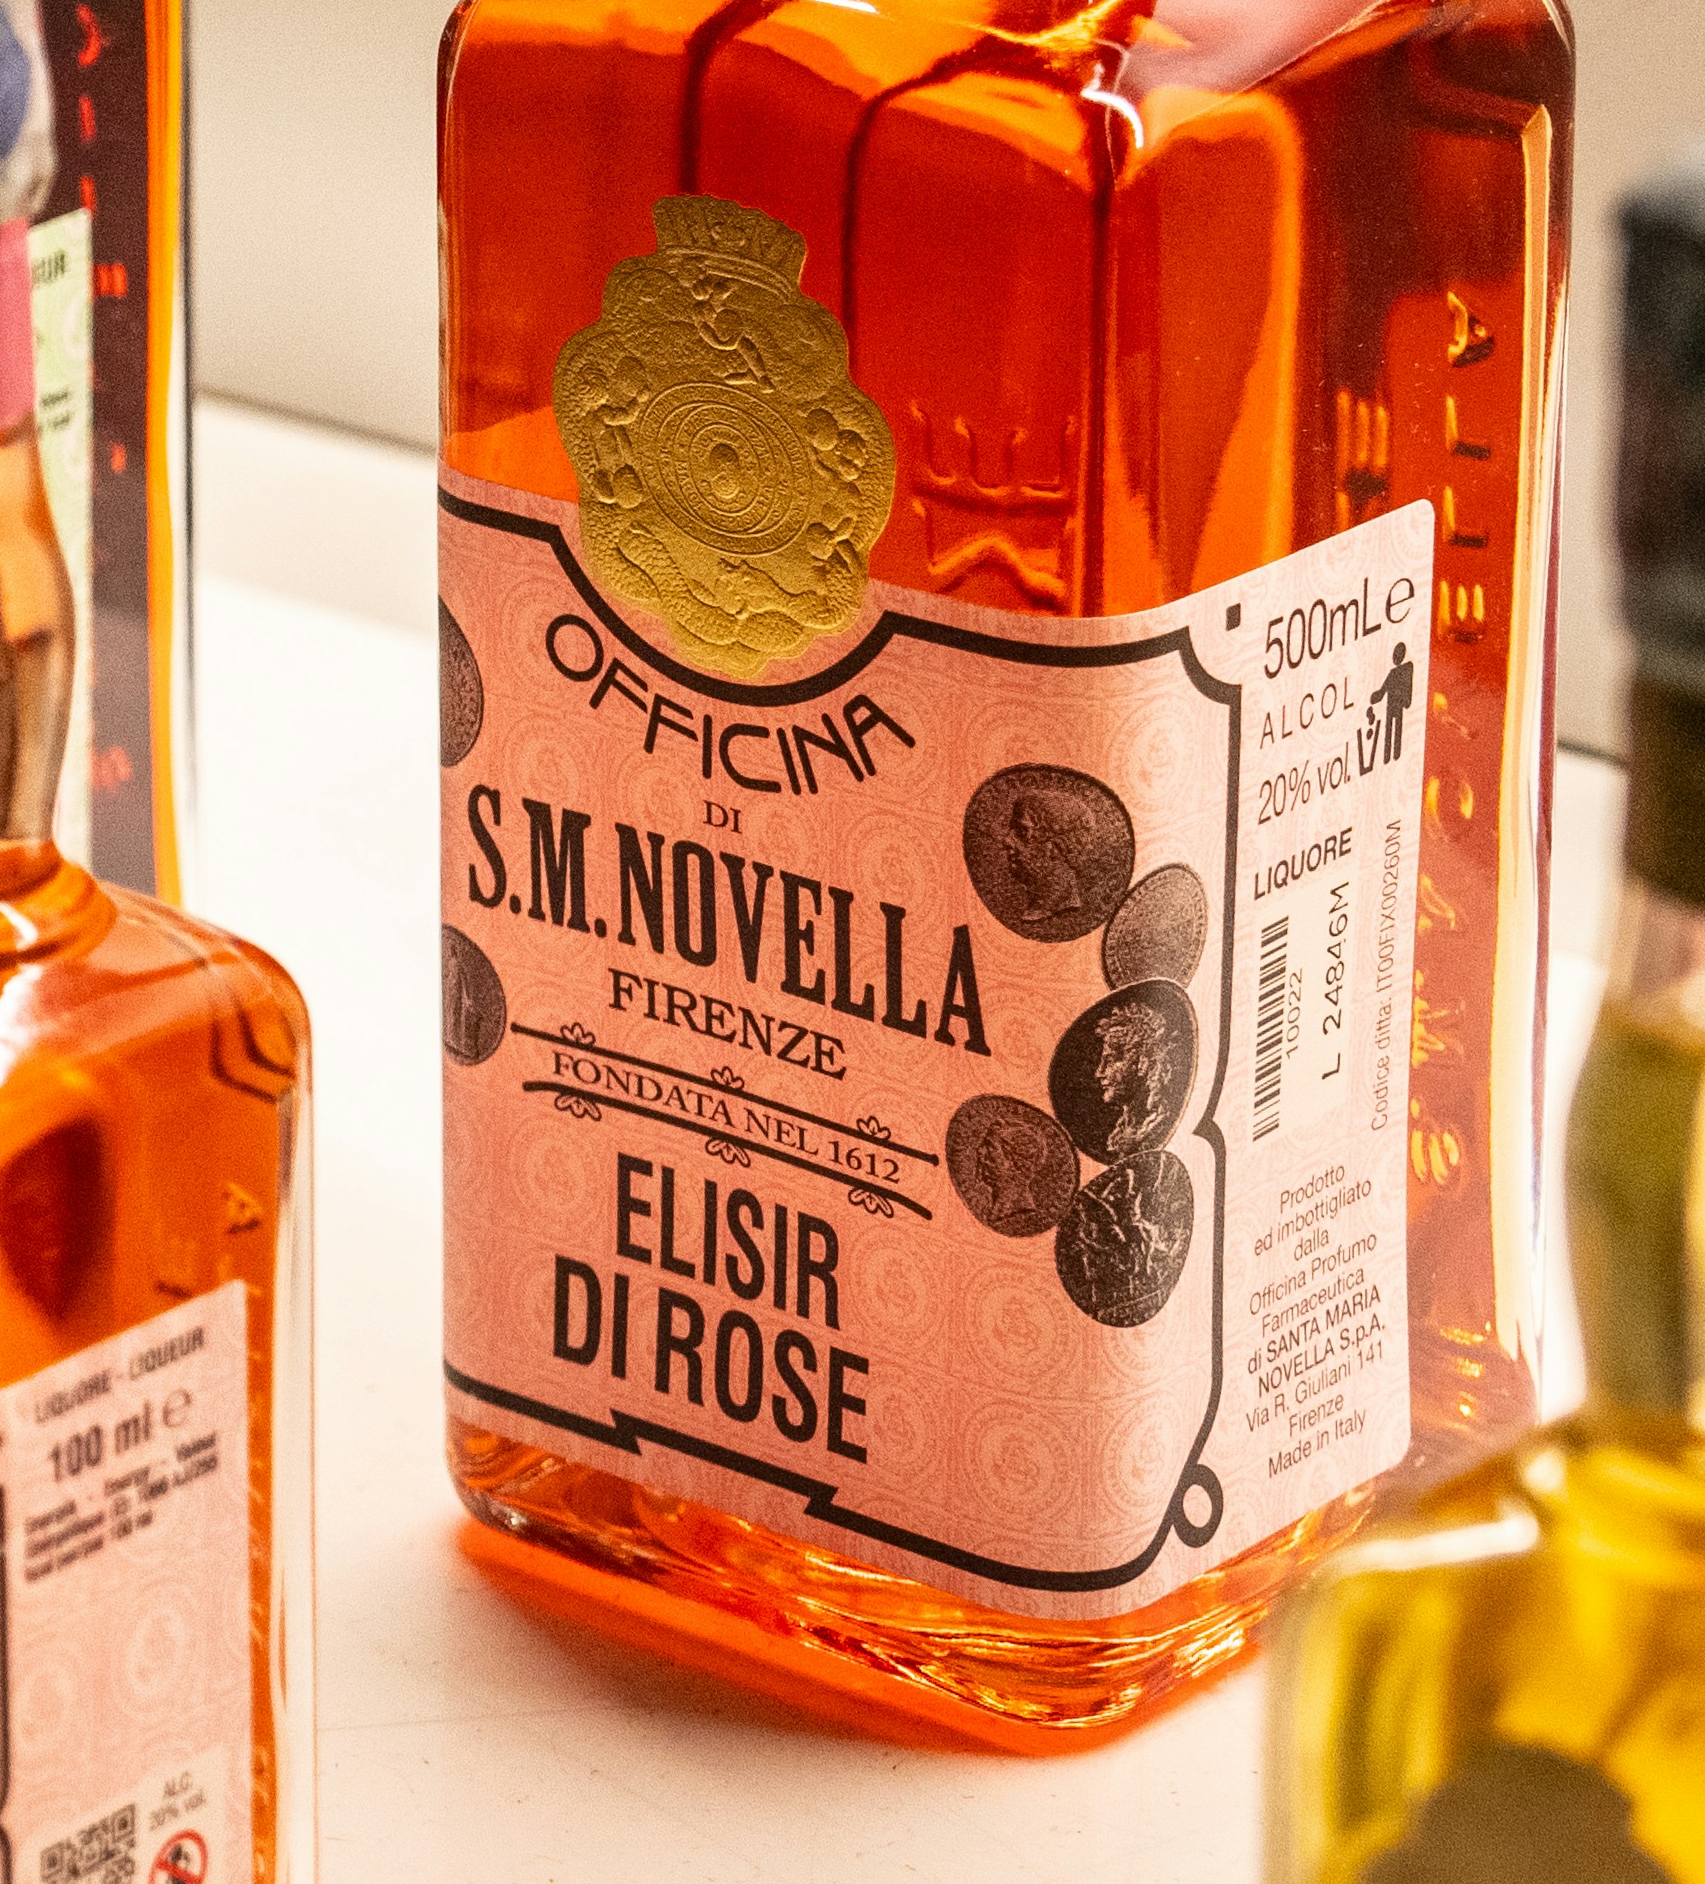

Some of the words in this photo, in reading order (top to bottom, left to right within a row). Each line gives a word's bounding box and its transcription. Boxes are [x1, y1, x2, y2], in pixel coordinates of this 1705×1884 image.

[545, 614, 916, 796] OFFICINA
[1260, 676, 1354, 750] ALCOL
[702, 800, 742, 834] DI
[1257, 759, 1311, 826] 20%
[1317, 741, 1351, 797] vol.
[1254, 826, 1353, 901] LIQUORE
[468, 783, 992, 1057] S.M.NOVELLA
[1322, 881, 1350, 1036] 24846M
[608, 967, 847, 1080] FIRENZE
[1286, 967, 1304, 1060] 10022
[1374, 997, 1392, 1049] ditta:
[1321, 1052, 1341, 1081] L
[1371, 1055, 1391, 1132] Codice
[551, 1051, 735, 1128] FONDATA
[744, 1108, 819, 1155] NEL
[828, 1138, 901, 1184] 1612
[1253, 1230, 1274, 1257] ed
[1276, 1179, 1373, 1245] imbottigliato
[1279, 1164, 1346, 1214] Prodotto
[616, 1152, 841, 1330] ELISIR
[1249, 1275, 1307, 1316] Officina
[1311, 1233, 1378, 1282] Profumo
[1293, 1228, 1330, 1262] dalla
[1247, 1348, 1263, 1375] di
[1266, 1321, 1321, 1365] SANTA
[1325, 1284, 1382, 1330] MARIA
[1261, 1267, 1366, 1339] Farmaceutica
[552, 1255, 631, 1379] DI
[654, 1288, 870, 1464] ROSE
[1245, 1406, 1270, 1434] Via
[1274, 1392, 1290, 1417] R.
[1295, 1360, 1352, 1406] Giuliani
[1357, 1339, 1384, 1375] 141
[1257, 1337, 1335, 1399] NOVELLA
[1339, 1313, 1386, 1351] S.p.A.
[48, 1422, 104, 1484] 100
[114, 1399, 153, 1455] ml
[1267, 1443, 1313, 1479] Made
[1316, 1430, 1330, 1453] in
[1334, 1409, 1367, 1440] Italy
[1288, 1392, 1345, 1438] Firenze
